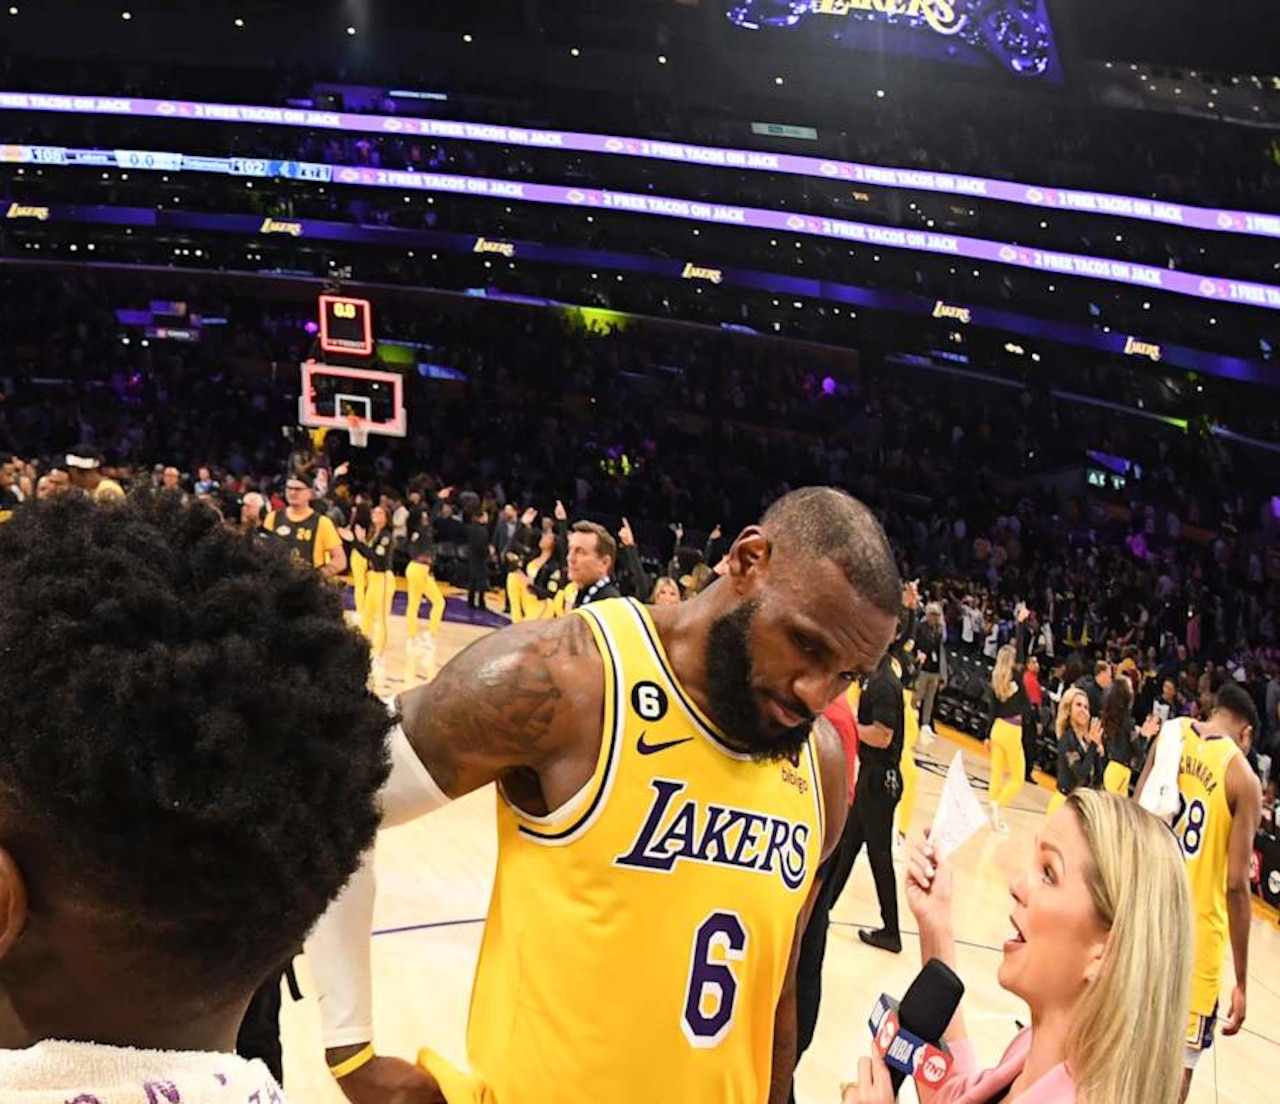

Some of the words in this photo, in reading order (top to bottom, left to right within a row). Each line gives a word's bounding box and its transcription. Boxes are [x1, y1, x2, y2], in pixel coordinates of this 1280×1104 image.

[637, 685, 660, 718] 6
[611, 777, 809, 893] LAKERS
[680, 907, 749, 1049] 6
[925, 1061, 945, 1078] TNT
